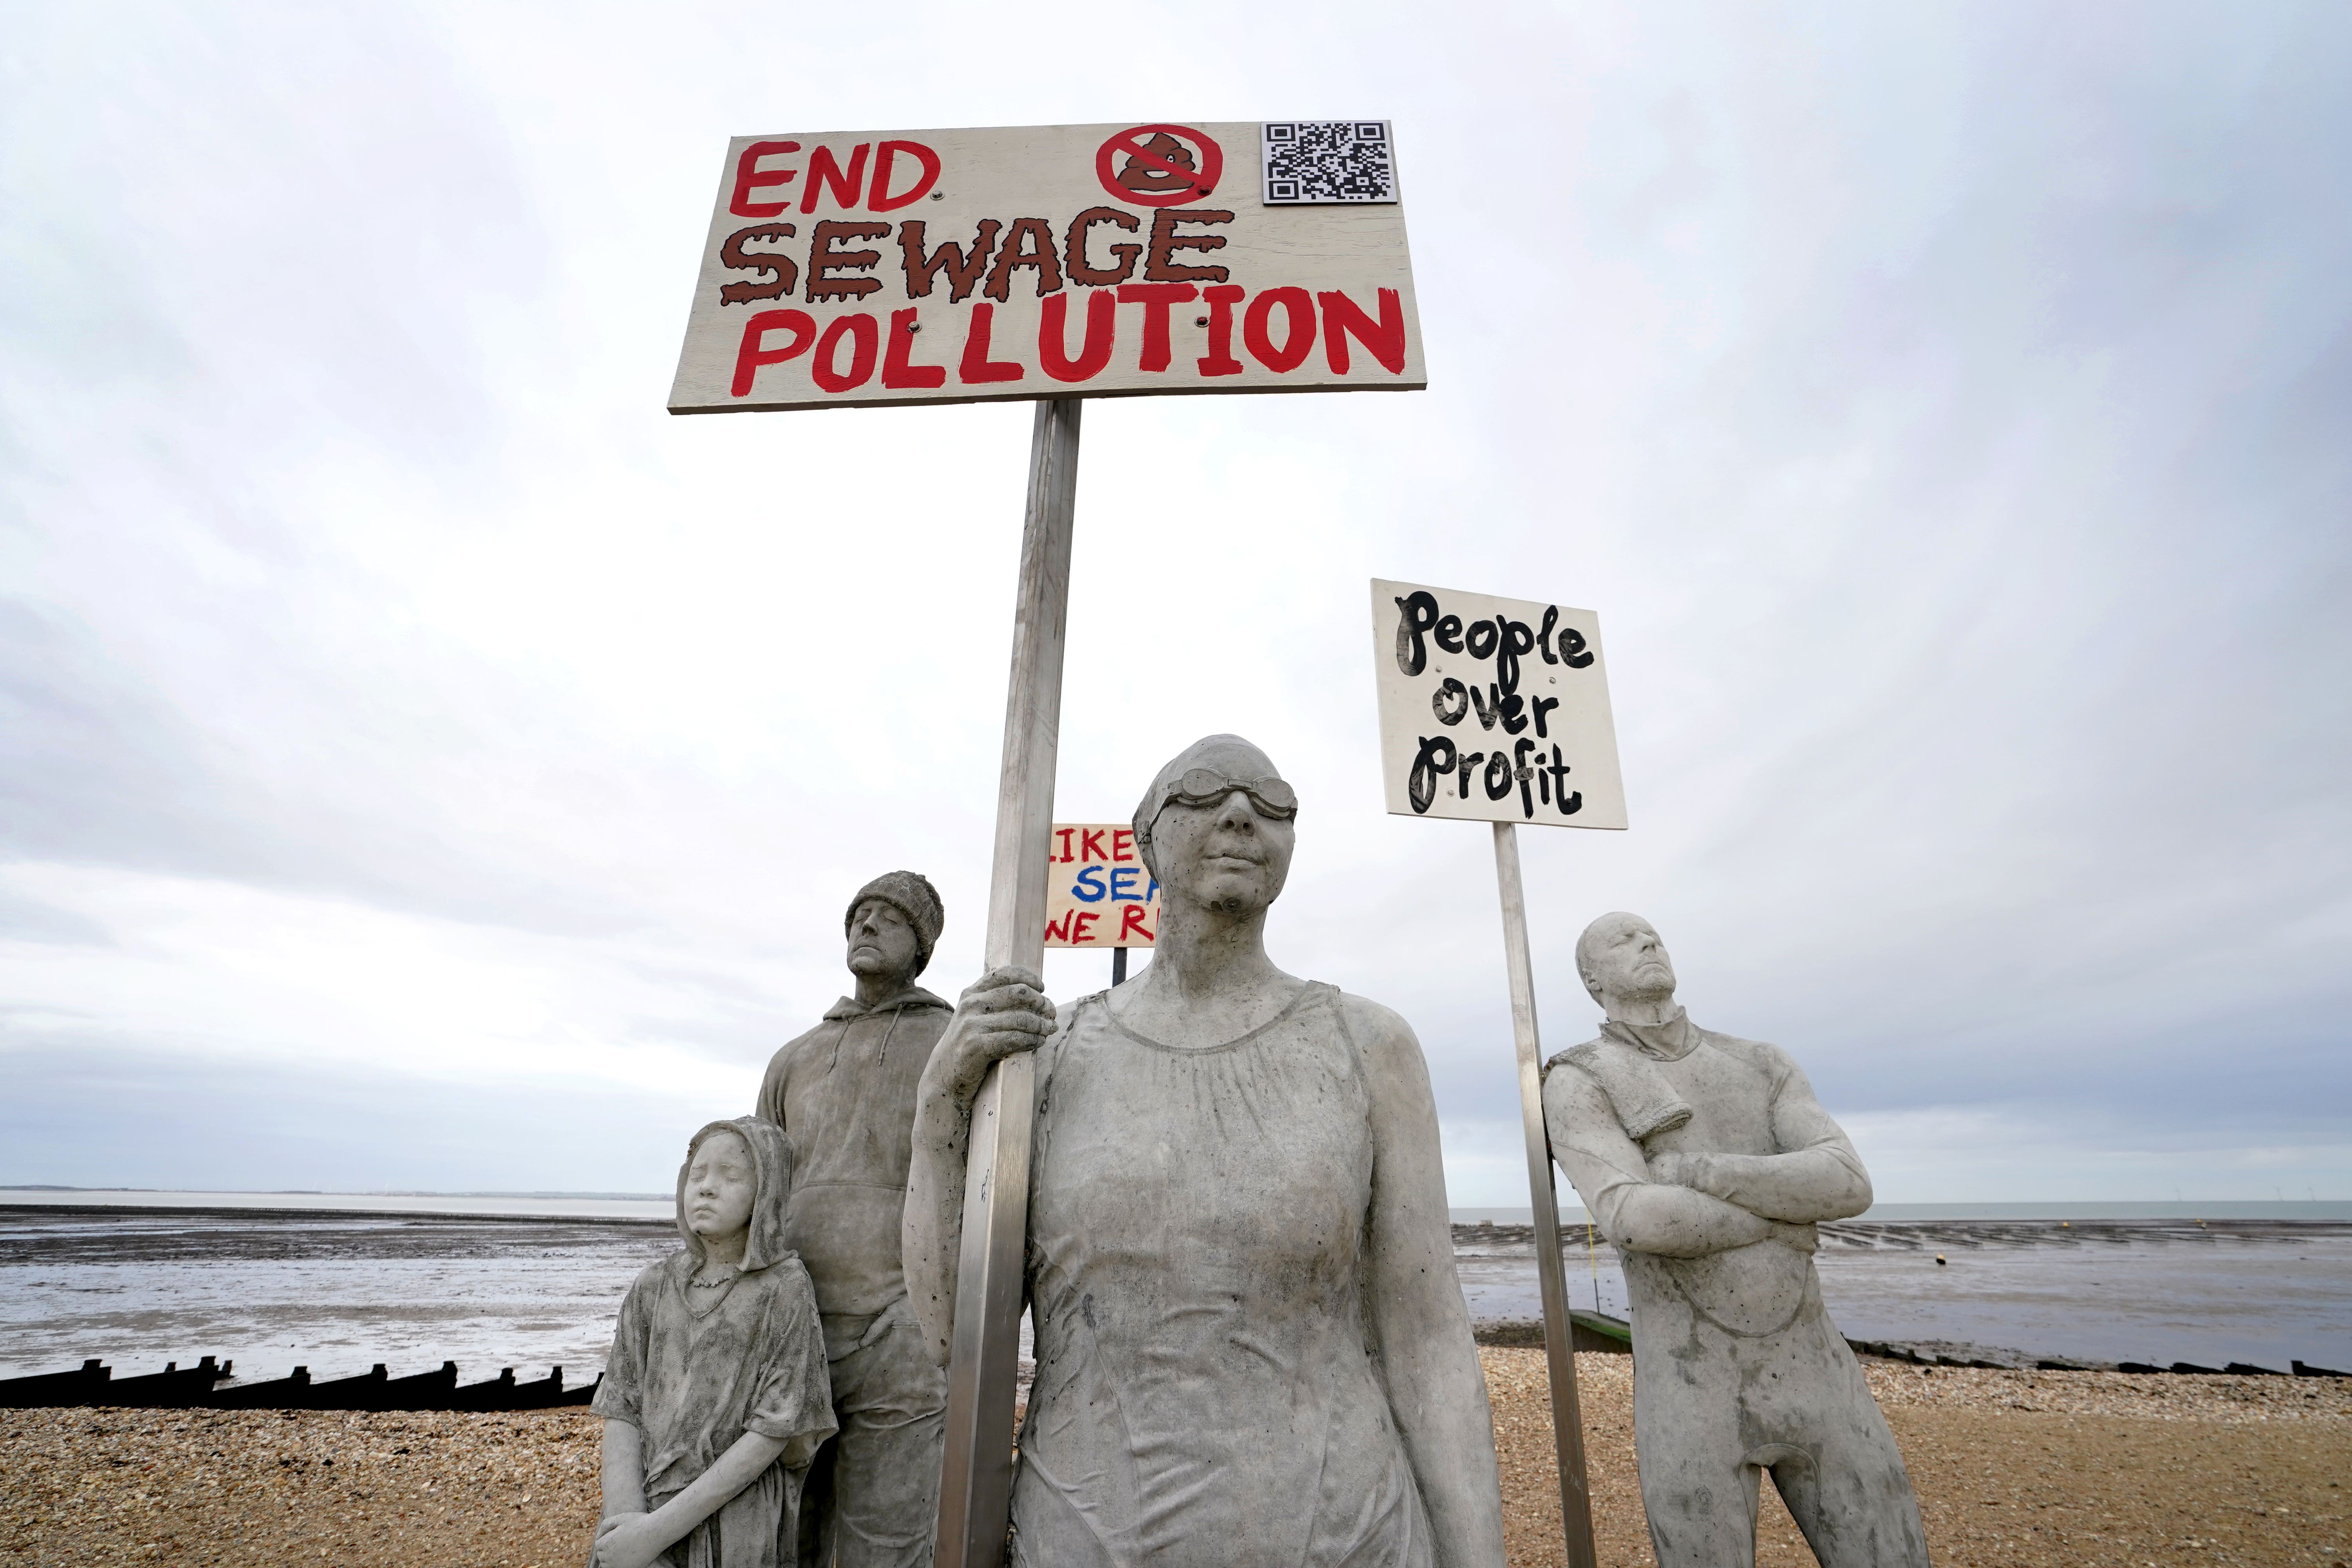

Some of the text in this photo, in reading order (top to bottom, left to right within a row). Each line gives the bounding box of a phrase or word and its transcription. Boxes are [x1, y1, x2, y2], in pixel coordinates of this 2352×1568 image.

[730, 140, 941, 218] END
[720, 205, 1236, 307] SEWAGE
[731, 282, 1405, 397] POLLUTION
[1432, 678, 1559, 738] over
[1049, 828, 1134, 863] IKE
